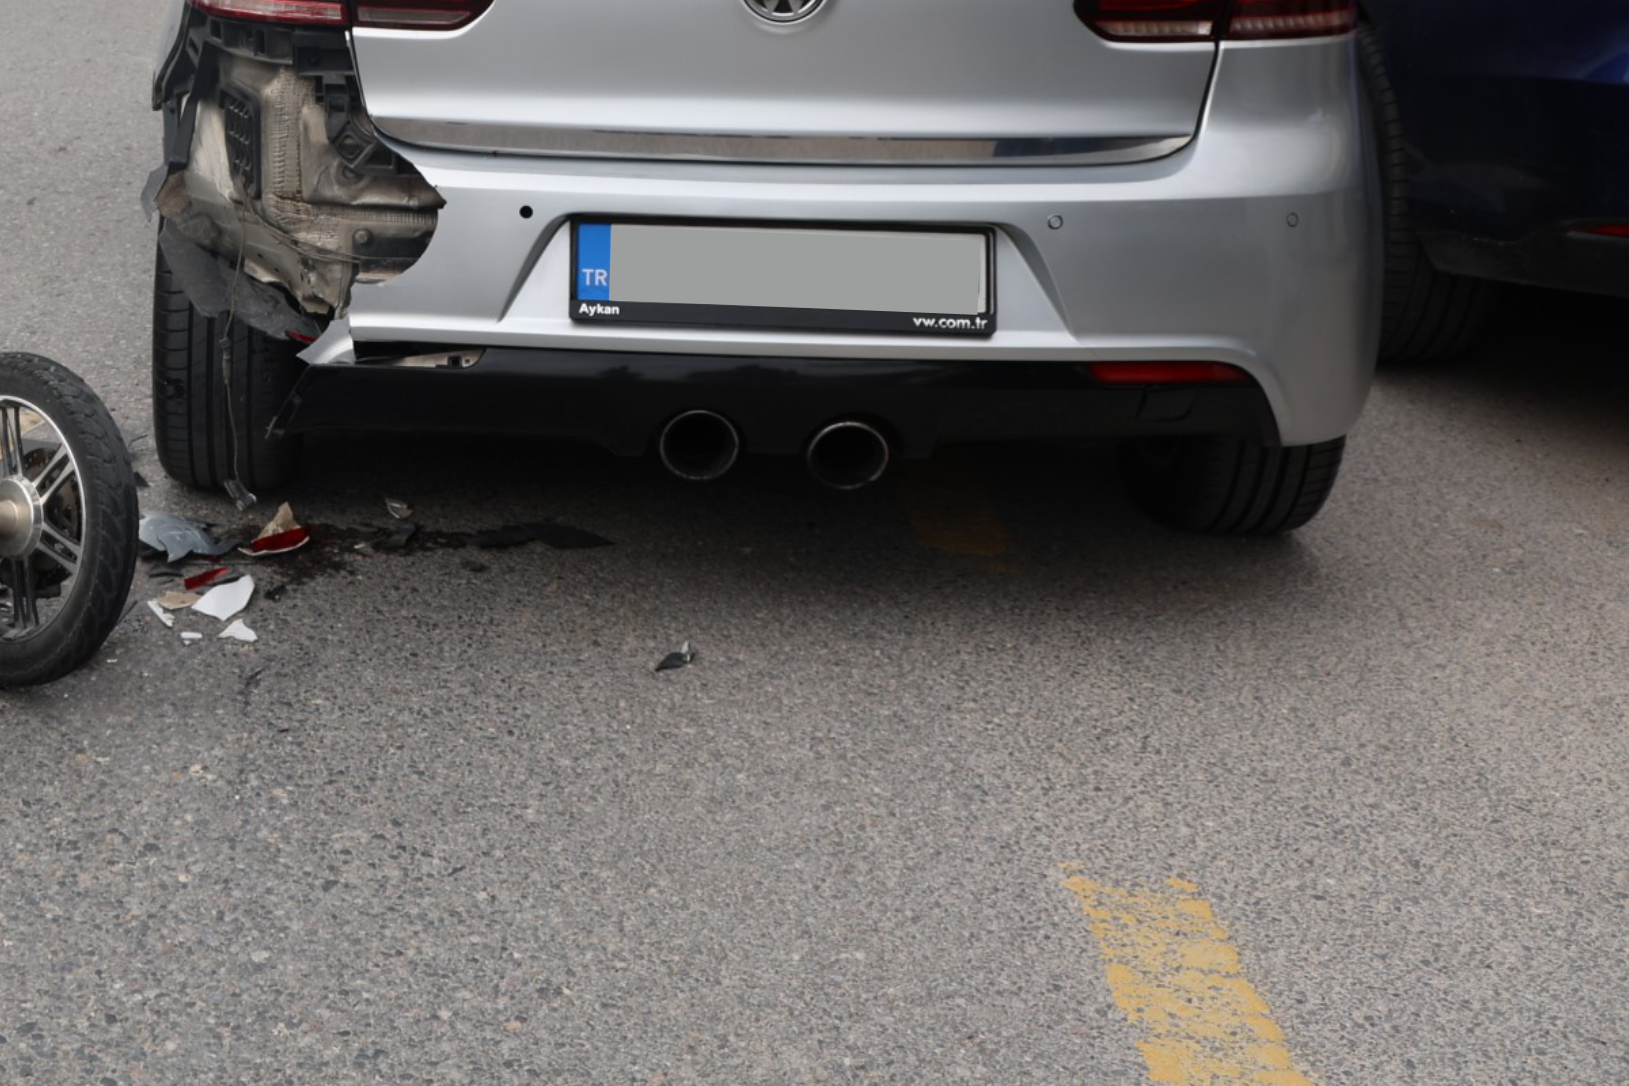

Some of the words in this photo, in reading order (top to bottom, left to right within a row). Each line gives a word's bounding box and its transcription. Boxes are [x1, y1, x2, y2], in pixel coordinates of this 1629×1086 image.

[582, 268, 608, 288] TR
[578, 302, 621, 318] Aykan
[912, 315, 988, 331] vw.com.tr
